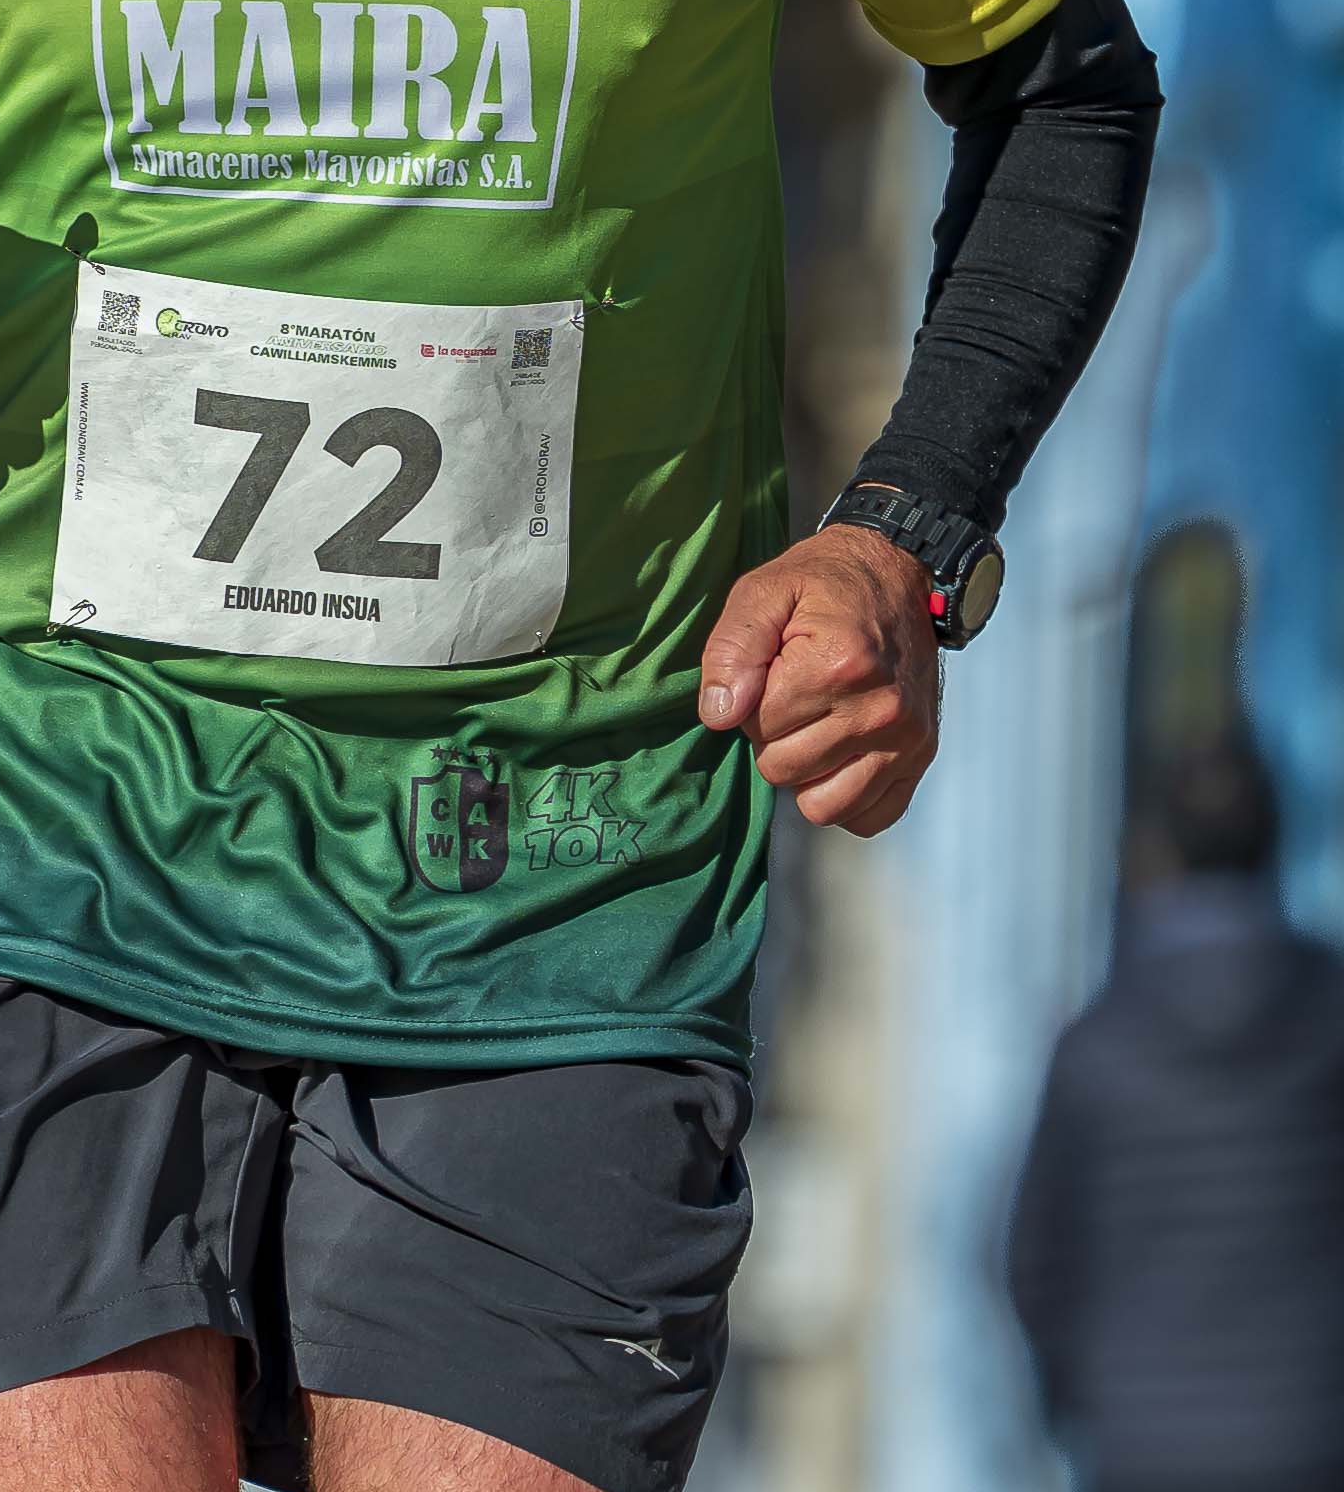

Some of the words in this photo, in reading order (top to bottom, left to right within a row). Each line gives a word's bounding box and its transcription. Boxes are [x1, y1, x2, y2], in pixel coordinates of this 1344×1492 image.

[119, 0, 537, 143] MAIRA
[131, 143, 293, 181] Almacenes
[302, 149, 469, 190] Mayoristas
[477, 153, 533, 189] S.A.
[250, 345, 397, 369] CAWILLIAMSKEMMIS
[438, 345, 448, 356] la
[75, 382, 89, 501] WWW.CRONORAV.COM.AR
[192, 387, 443, 581] 72
[534, 433, 551, 515] @CRONORAV
[224, 584, 316, 617] EDUARDO
[322, 591, 381, 623] INSUA
[431, 798, 450, 822] C
[467, 803, 490, 826] A
[526, 770, 620, 824] 4K
[426, 833, 454, 858] W
[468, 838, 491, 860] K
[524, 820, 647, 872] 10K
